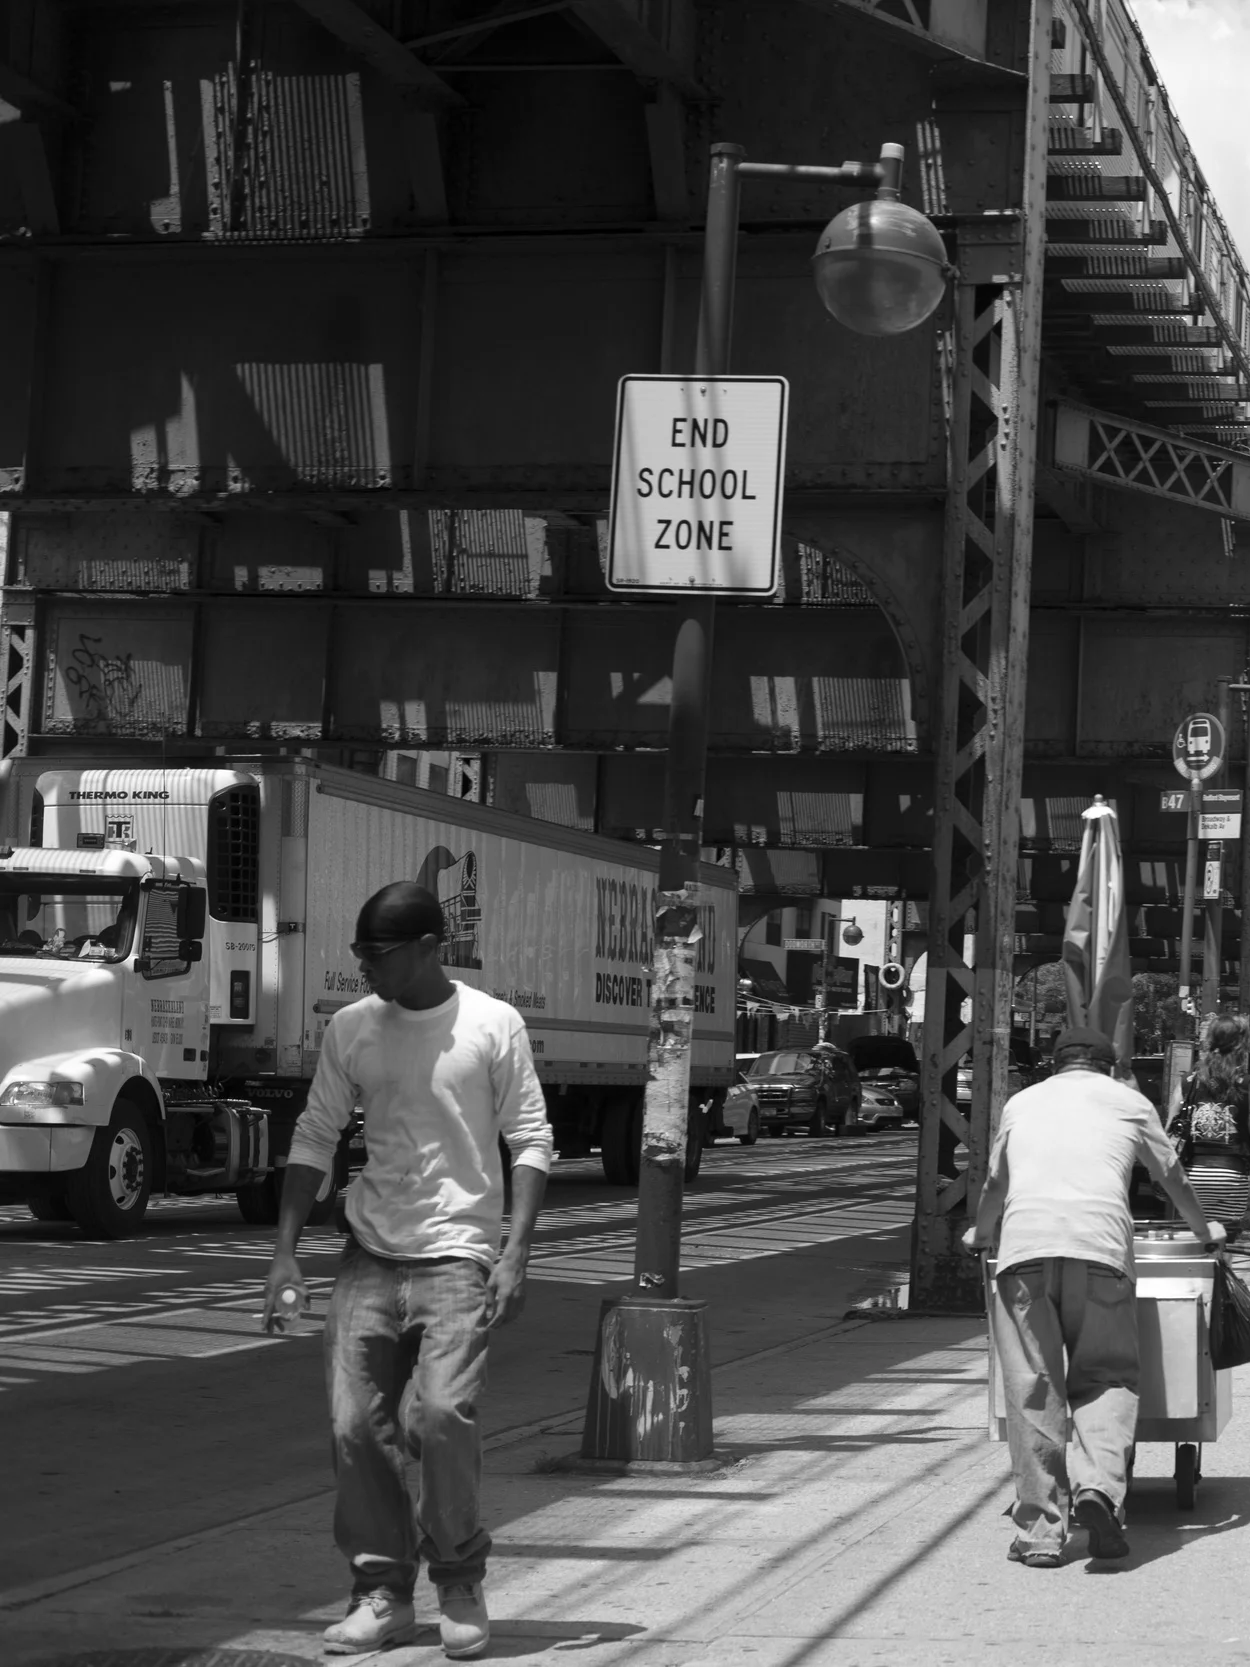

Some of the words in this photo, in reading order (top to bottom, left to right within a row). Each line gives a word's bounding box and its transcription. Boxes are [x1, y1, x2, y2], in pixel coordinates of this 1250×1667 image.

[671, 417, 729, 448] END
[636, 467, 757, 500] SCHOOL
[654, 519, 734, 551] ZONE
[69, 791, 128, 800] THERMO
[132, 791, 170, 800] KING
[1161, 794, 1185, 809] B47
[324, 970, 337, 991] Full
[336, 972, 359, 994] Service
[595, 972, 642, 1007] DISCOVER
[245, 1087, 294, 1099] VOLVO
